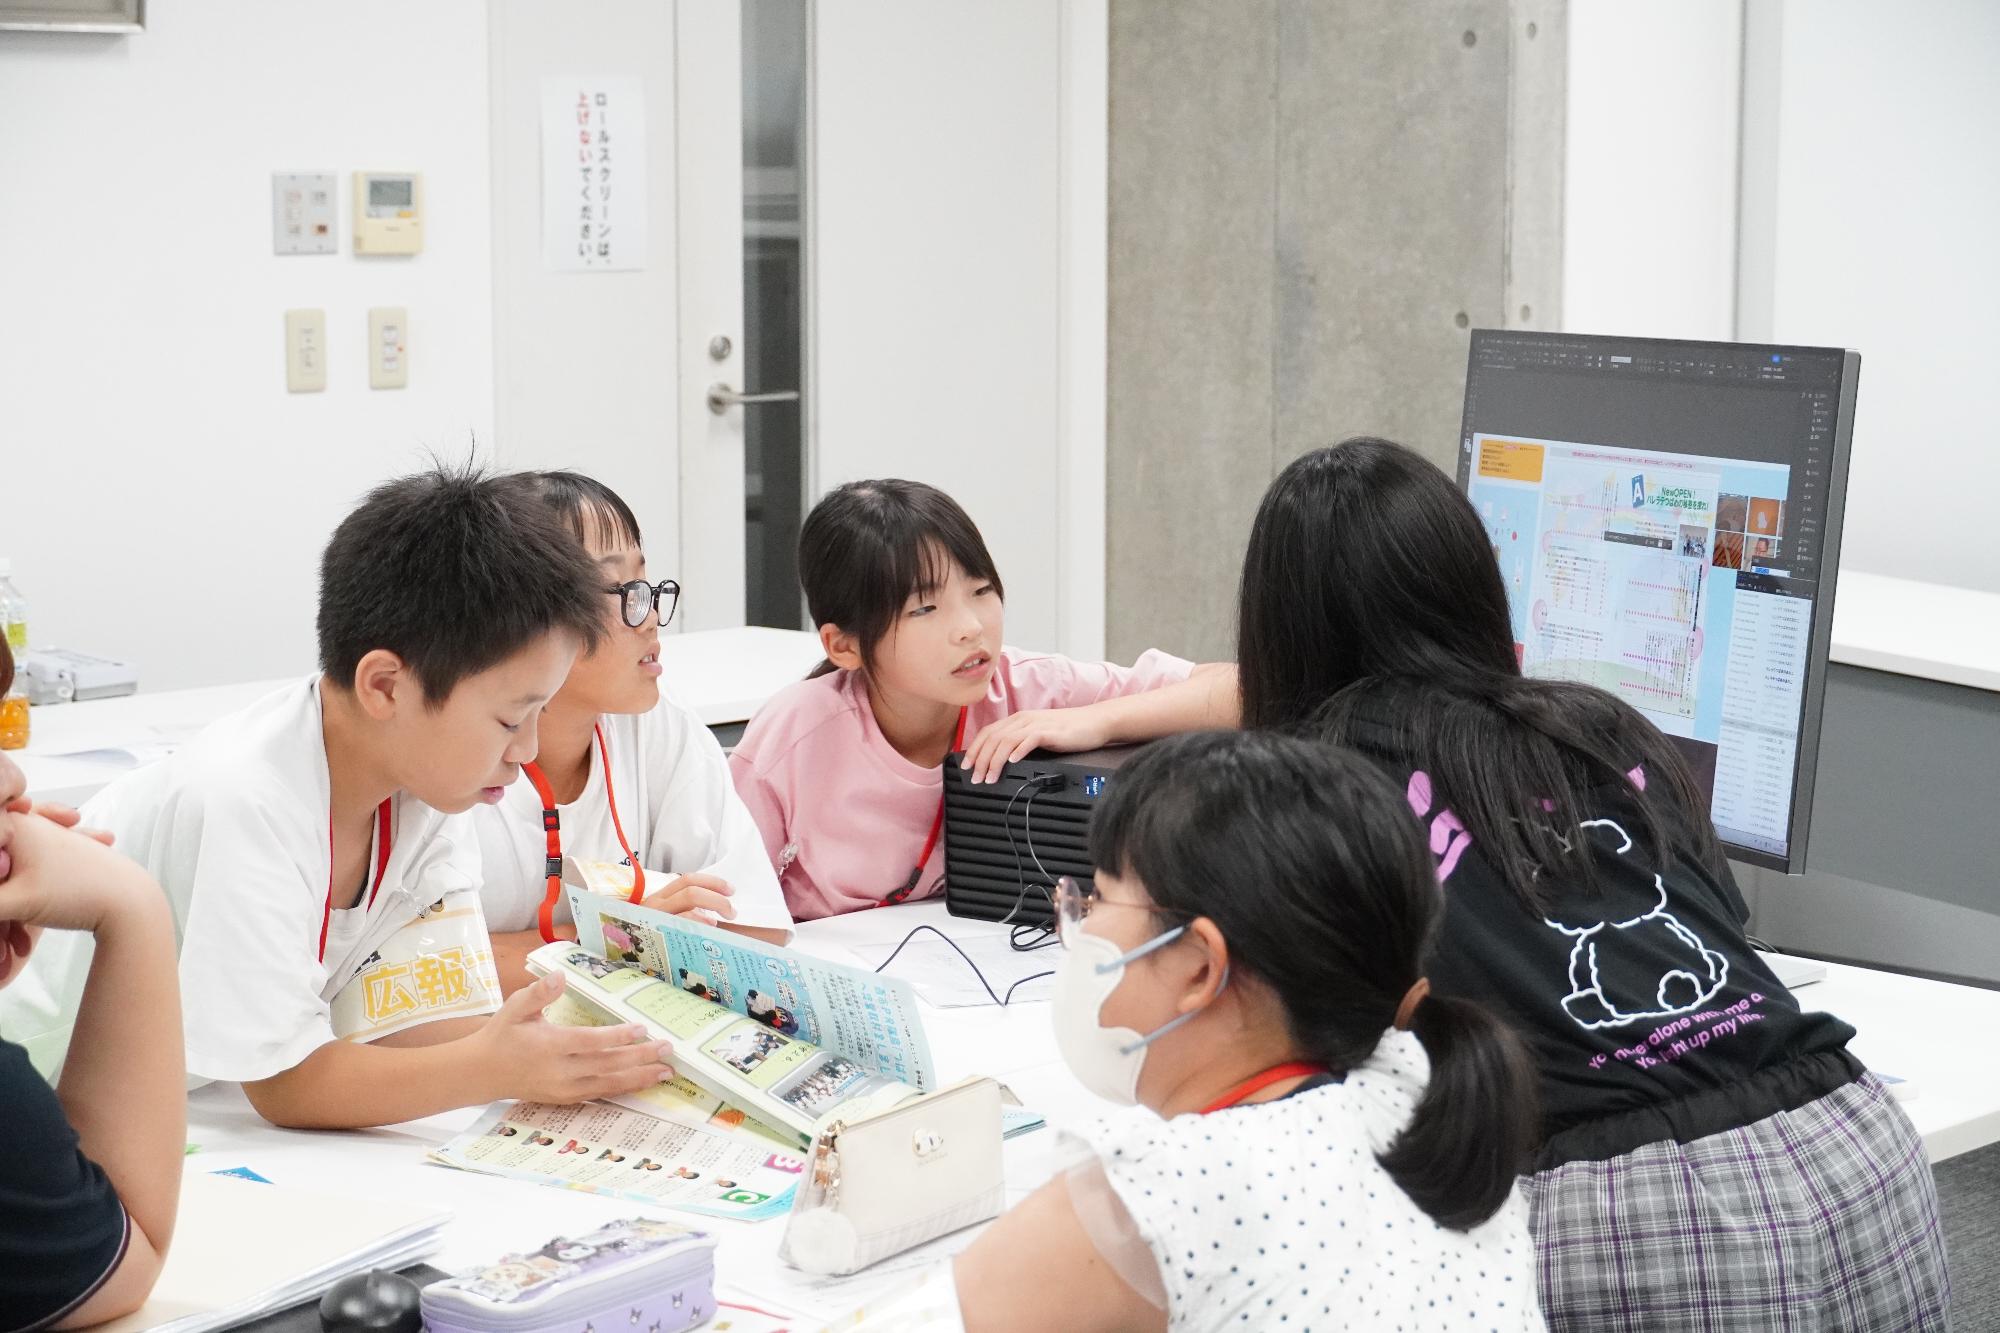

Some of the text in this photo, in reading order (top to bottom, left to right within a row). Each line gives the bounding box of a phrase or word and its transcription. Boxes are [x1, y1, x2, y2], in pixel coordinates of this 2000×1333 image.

[1633, 482, 1643, 504] A
[1648, 1017, 1691, 1045] alone
[1724, 999, 1750, 1015] me
[1688, 1030, 1710, 1048] up
[1712, 1018, 1737, 1038] my
